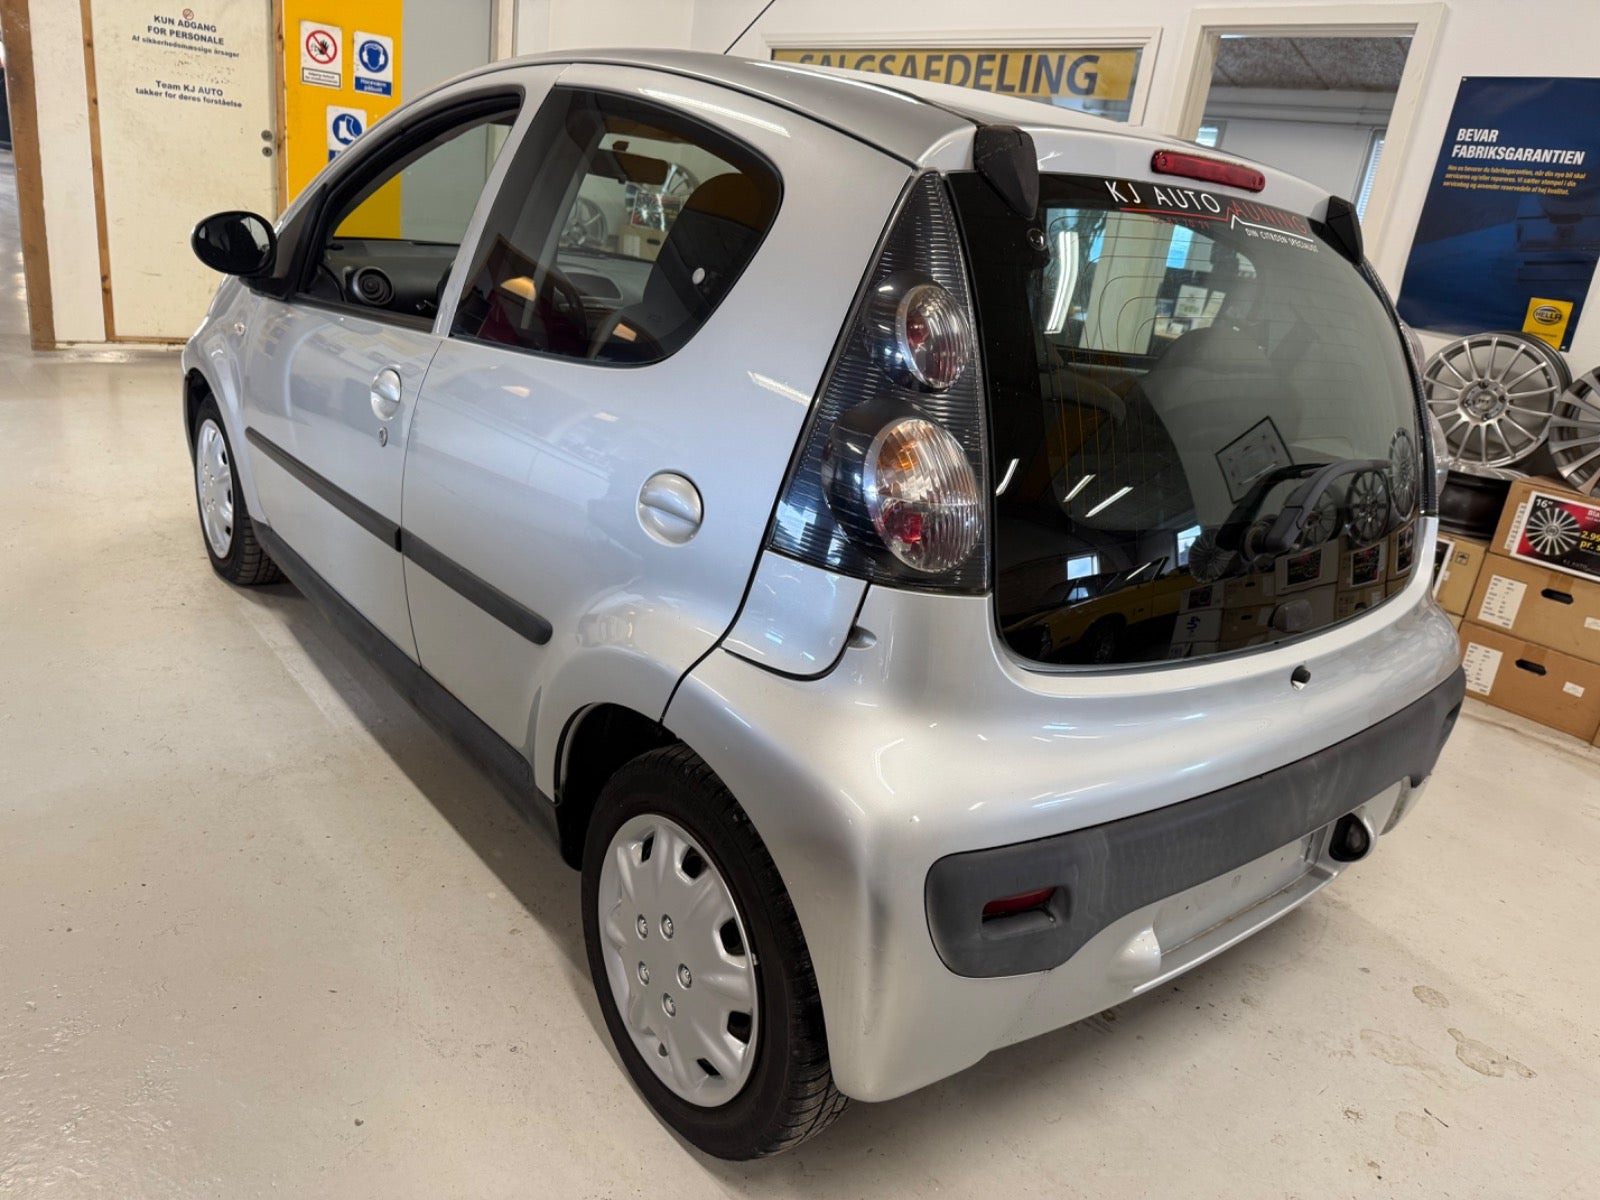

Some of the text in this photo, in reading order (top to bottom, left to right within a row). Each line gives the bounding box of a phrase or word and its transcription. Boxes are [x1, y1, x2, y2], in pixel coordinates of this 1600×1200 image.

[153, 15, 217, 33] KUN ADGANG
[147, 25, 225, 46] FOR PERSONALE
[135, 87, 163, 98] takker
[165, 91, 176, 99] for
[178, 93, 201, 103] deres
[155, 80, 224, 97] Team KJ AUTO
[1456, 128, 1499, 143] BEVAR
[1451, 144, 1586, 165] FABRIKSGARANTIEN
[1153, 185, 1221, 213] AUTO
[1535, 311, 1563, 321] HELLA
